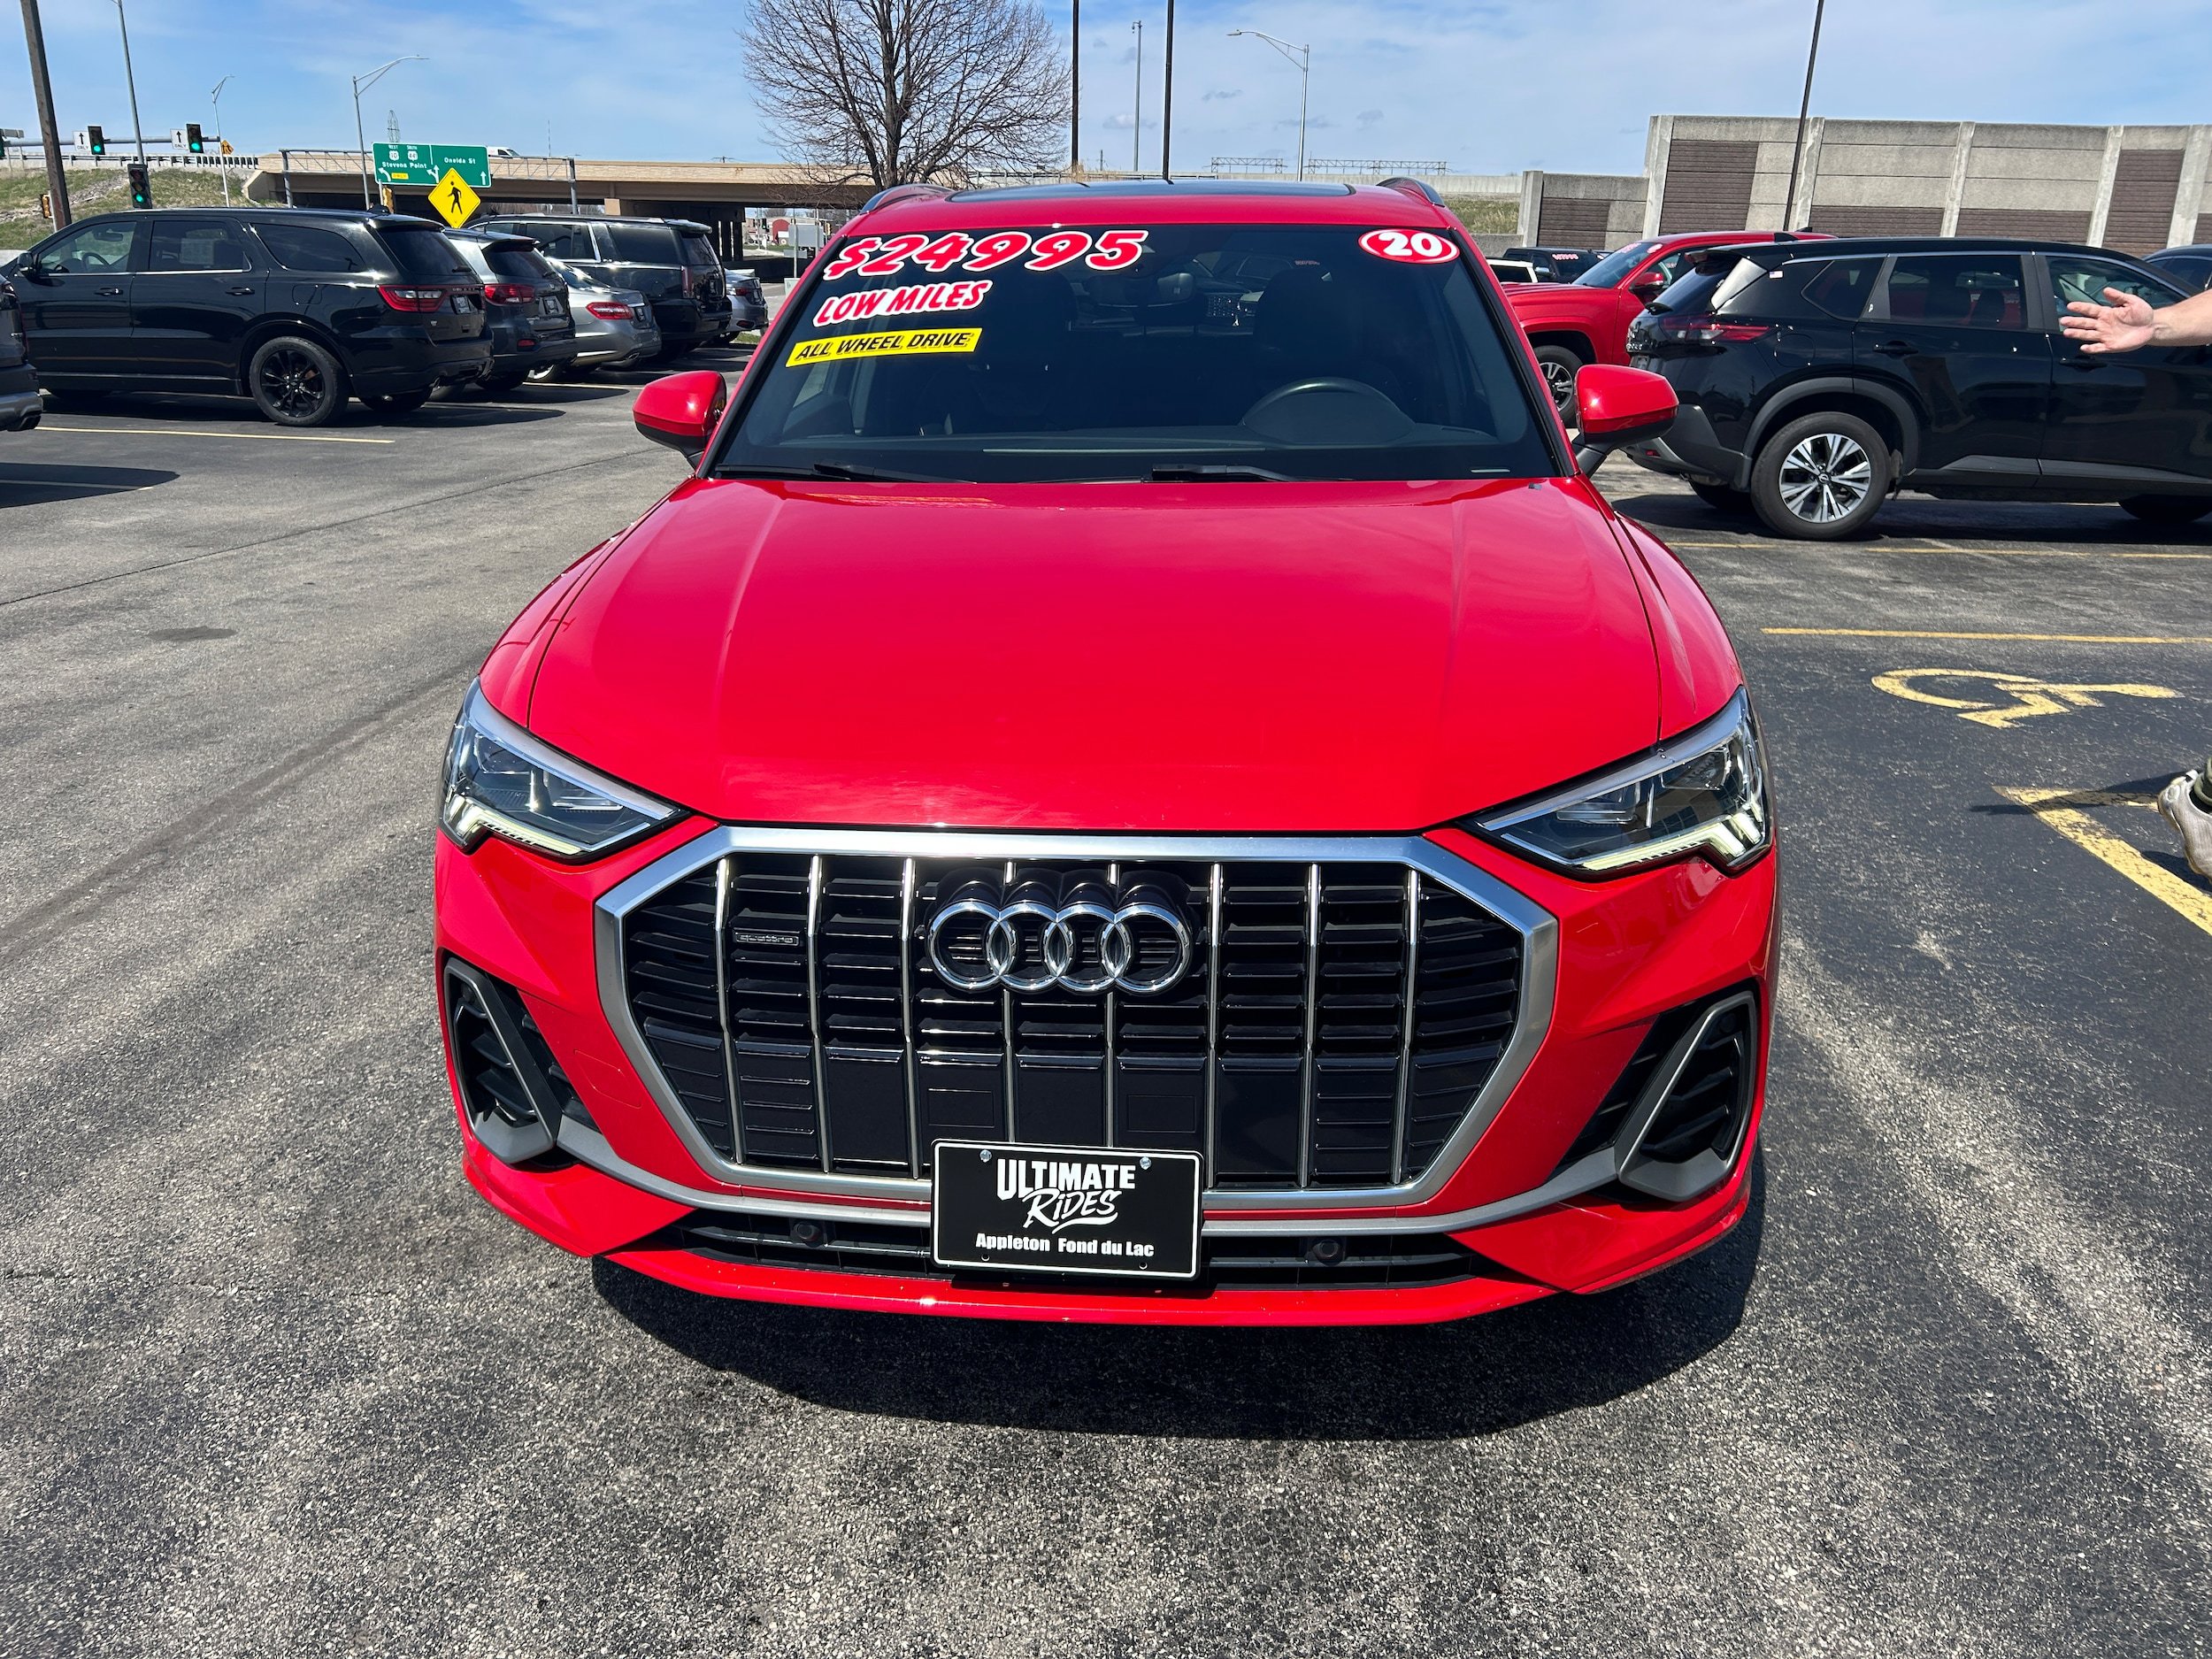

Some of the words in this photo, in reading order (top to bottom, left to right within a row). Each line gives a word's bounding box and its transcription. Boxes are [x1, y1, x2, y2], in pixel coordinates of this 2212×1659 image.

[823, 230, 1149, 280] $24995
[1378, 231, 1443, 257] 20
[815, 291, 886, 326] LOW
[888, 280, 992, 314] MILES
[795, 342, 830, 361] ALL
[836, 335, 903, 354] WHEEL
[908, 332, 973, 349] DRIVE
[996, 1158, 1137, 1201] ULTIMATE
[975, 1233, 1051, 1252] Appleton
[1057, 1237, 1099, 1255] Fond
[1101, 1239, 1123, 1256] du
[1125, 1241, 1155, 1257] Lac
